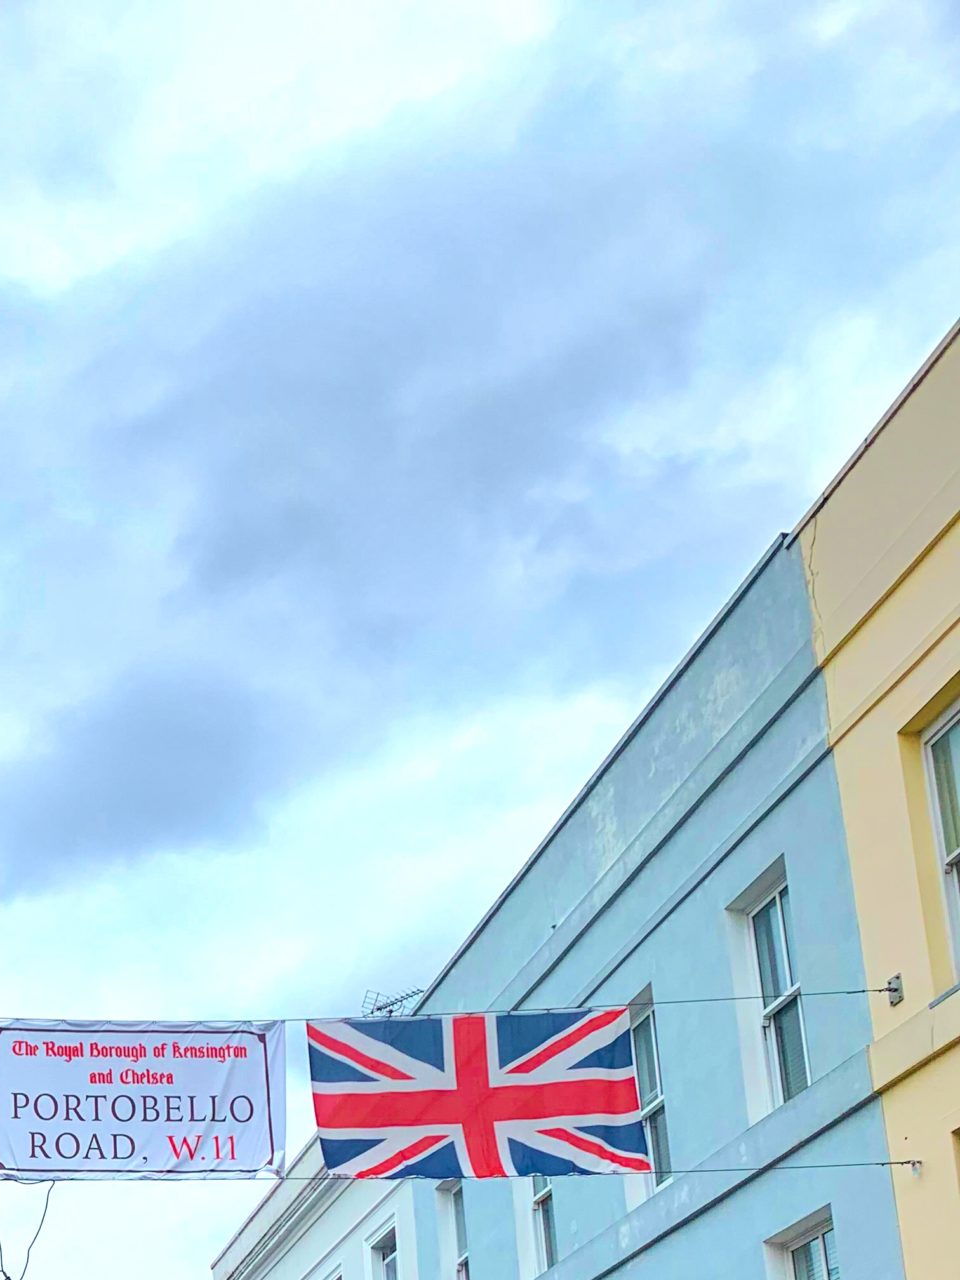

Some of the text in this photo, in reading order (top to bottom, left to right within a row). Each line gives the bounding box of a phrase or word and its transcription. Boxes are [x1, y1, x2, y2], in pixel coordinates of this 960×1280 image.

[12, 1040, 248, 1063] The Royal Borough of Kensington
[89, 1069, 174, 1085] and Chelsea
[10, 1092, 255, 1123] PORTOBELLO
[28, 1132, 237, 1164] ROAD, W.11
